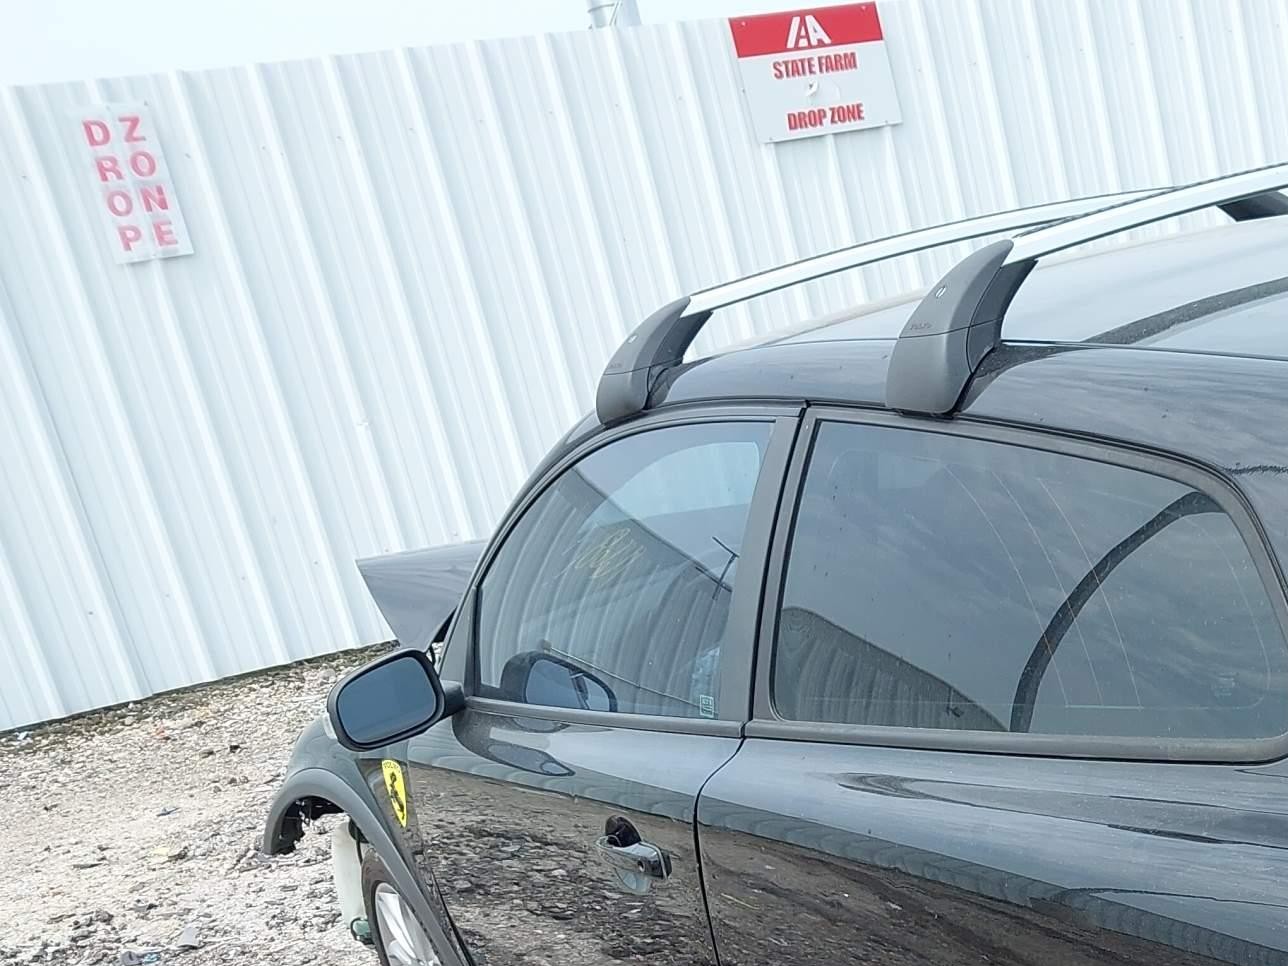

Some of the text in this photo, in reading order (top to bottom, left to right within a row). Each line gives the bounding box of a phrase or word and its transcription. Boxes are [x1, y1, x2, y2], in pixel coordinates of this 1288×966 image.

[773, 52, 857, 79] STATE FARM
[787, 103, 865, 131] DROP ZONE
[82, 119, 142, 251] DROP
[118, 115, 178, 247] ZONE
